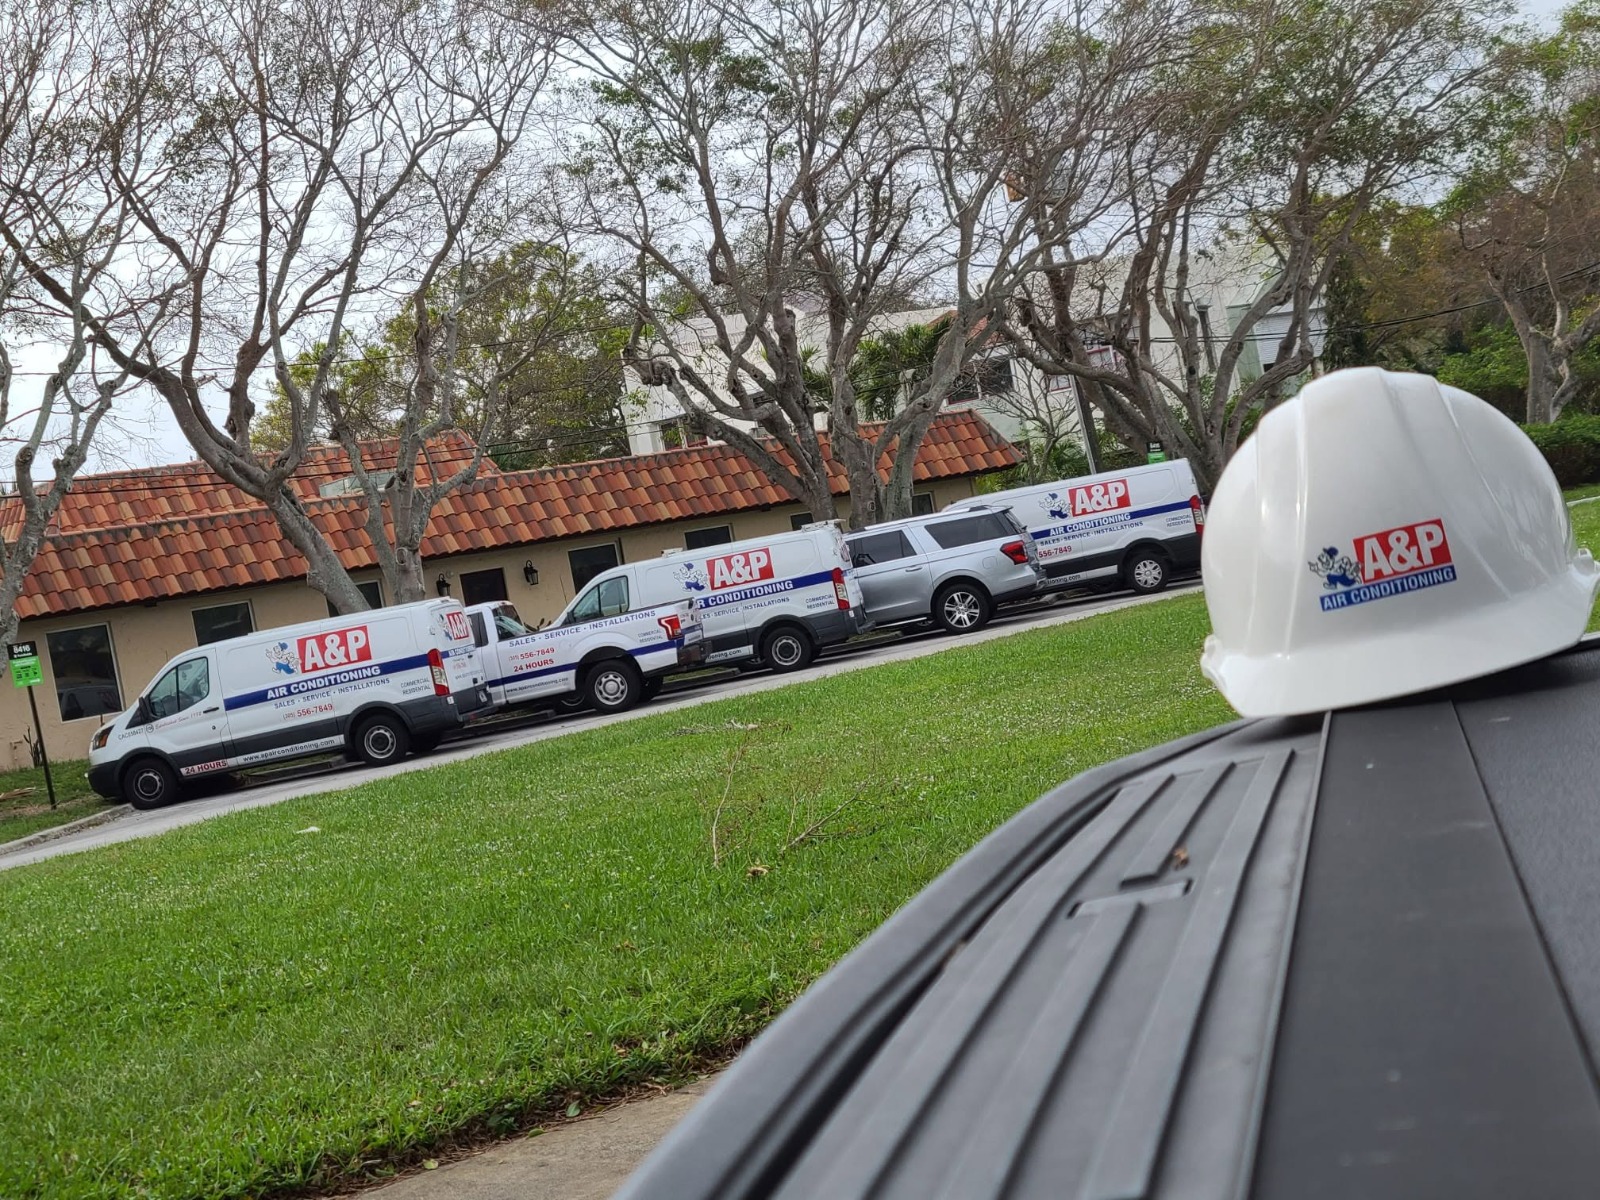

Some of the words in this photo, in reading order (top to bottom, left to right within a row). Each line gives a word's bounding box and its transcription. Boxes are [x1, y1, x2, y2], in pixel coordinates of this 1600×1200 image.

[1074, 481, 1126, 515] A&P
[1040, 537, 1060, 547] SALES
[1063, 531, 1091, 542] SERVICE
[1094, 521, 1144, 537] INSTALLATIONS
[1049, 526, 1065, 537] AIR
[1066, 512, 1131, 533] CONDITIONING
[1038, 545, 1072, 559] 556-7849
[1363, 523, 1443, 581] A&P
[714, 550, 768, 588] A&P
[708, 580, 794, 607] CONDITIONING
[1323, 594, 1349, 611] AIR
[1350, 567, 1454, 604] CONDITIONING
[714, 607, 739, 617] SERVICE
[742, 596, 790, 611] INSTALLATIONS
[509, 636, 536, 648] SALES
[544, 626, 581, 640] SERVICE
[589, 610, 656, 631] INSTALLATIONS
[304, 629, 367, 671] A&P
[519, 647, 555, 660] 556-7849
[513, 665, 524, 673] 24
[525, 658, 555, 670] HOURS
[267, 687, 289, 700] AIR
[290, 665, 381, 694] CONDITIONING
[274, 699, 296, 710] SALES
[302, 690, 331, 703] SERVICE
[338, 677, 390, 695] INSTALLATIONS
[400, 677, 430, 688] COMMERCIAL
[402, 685, 431, 695] RESIDENTIAL
[296, 703, 333, 718] 556-7849
[242, 739, 335, 762] www.apairconditioning.com
[184, 766, 196, 775] 24
[197, 760, 228, 773] HOURS
